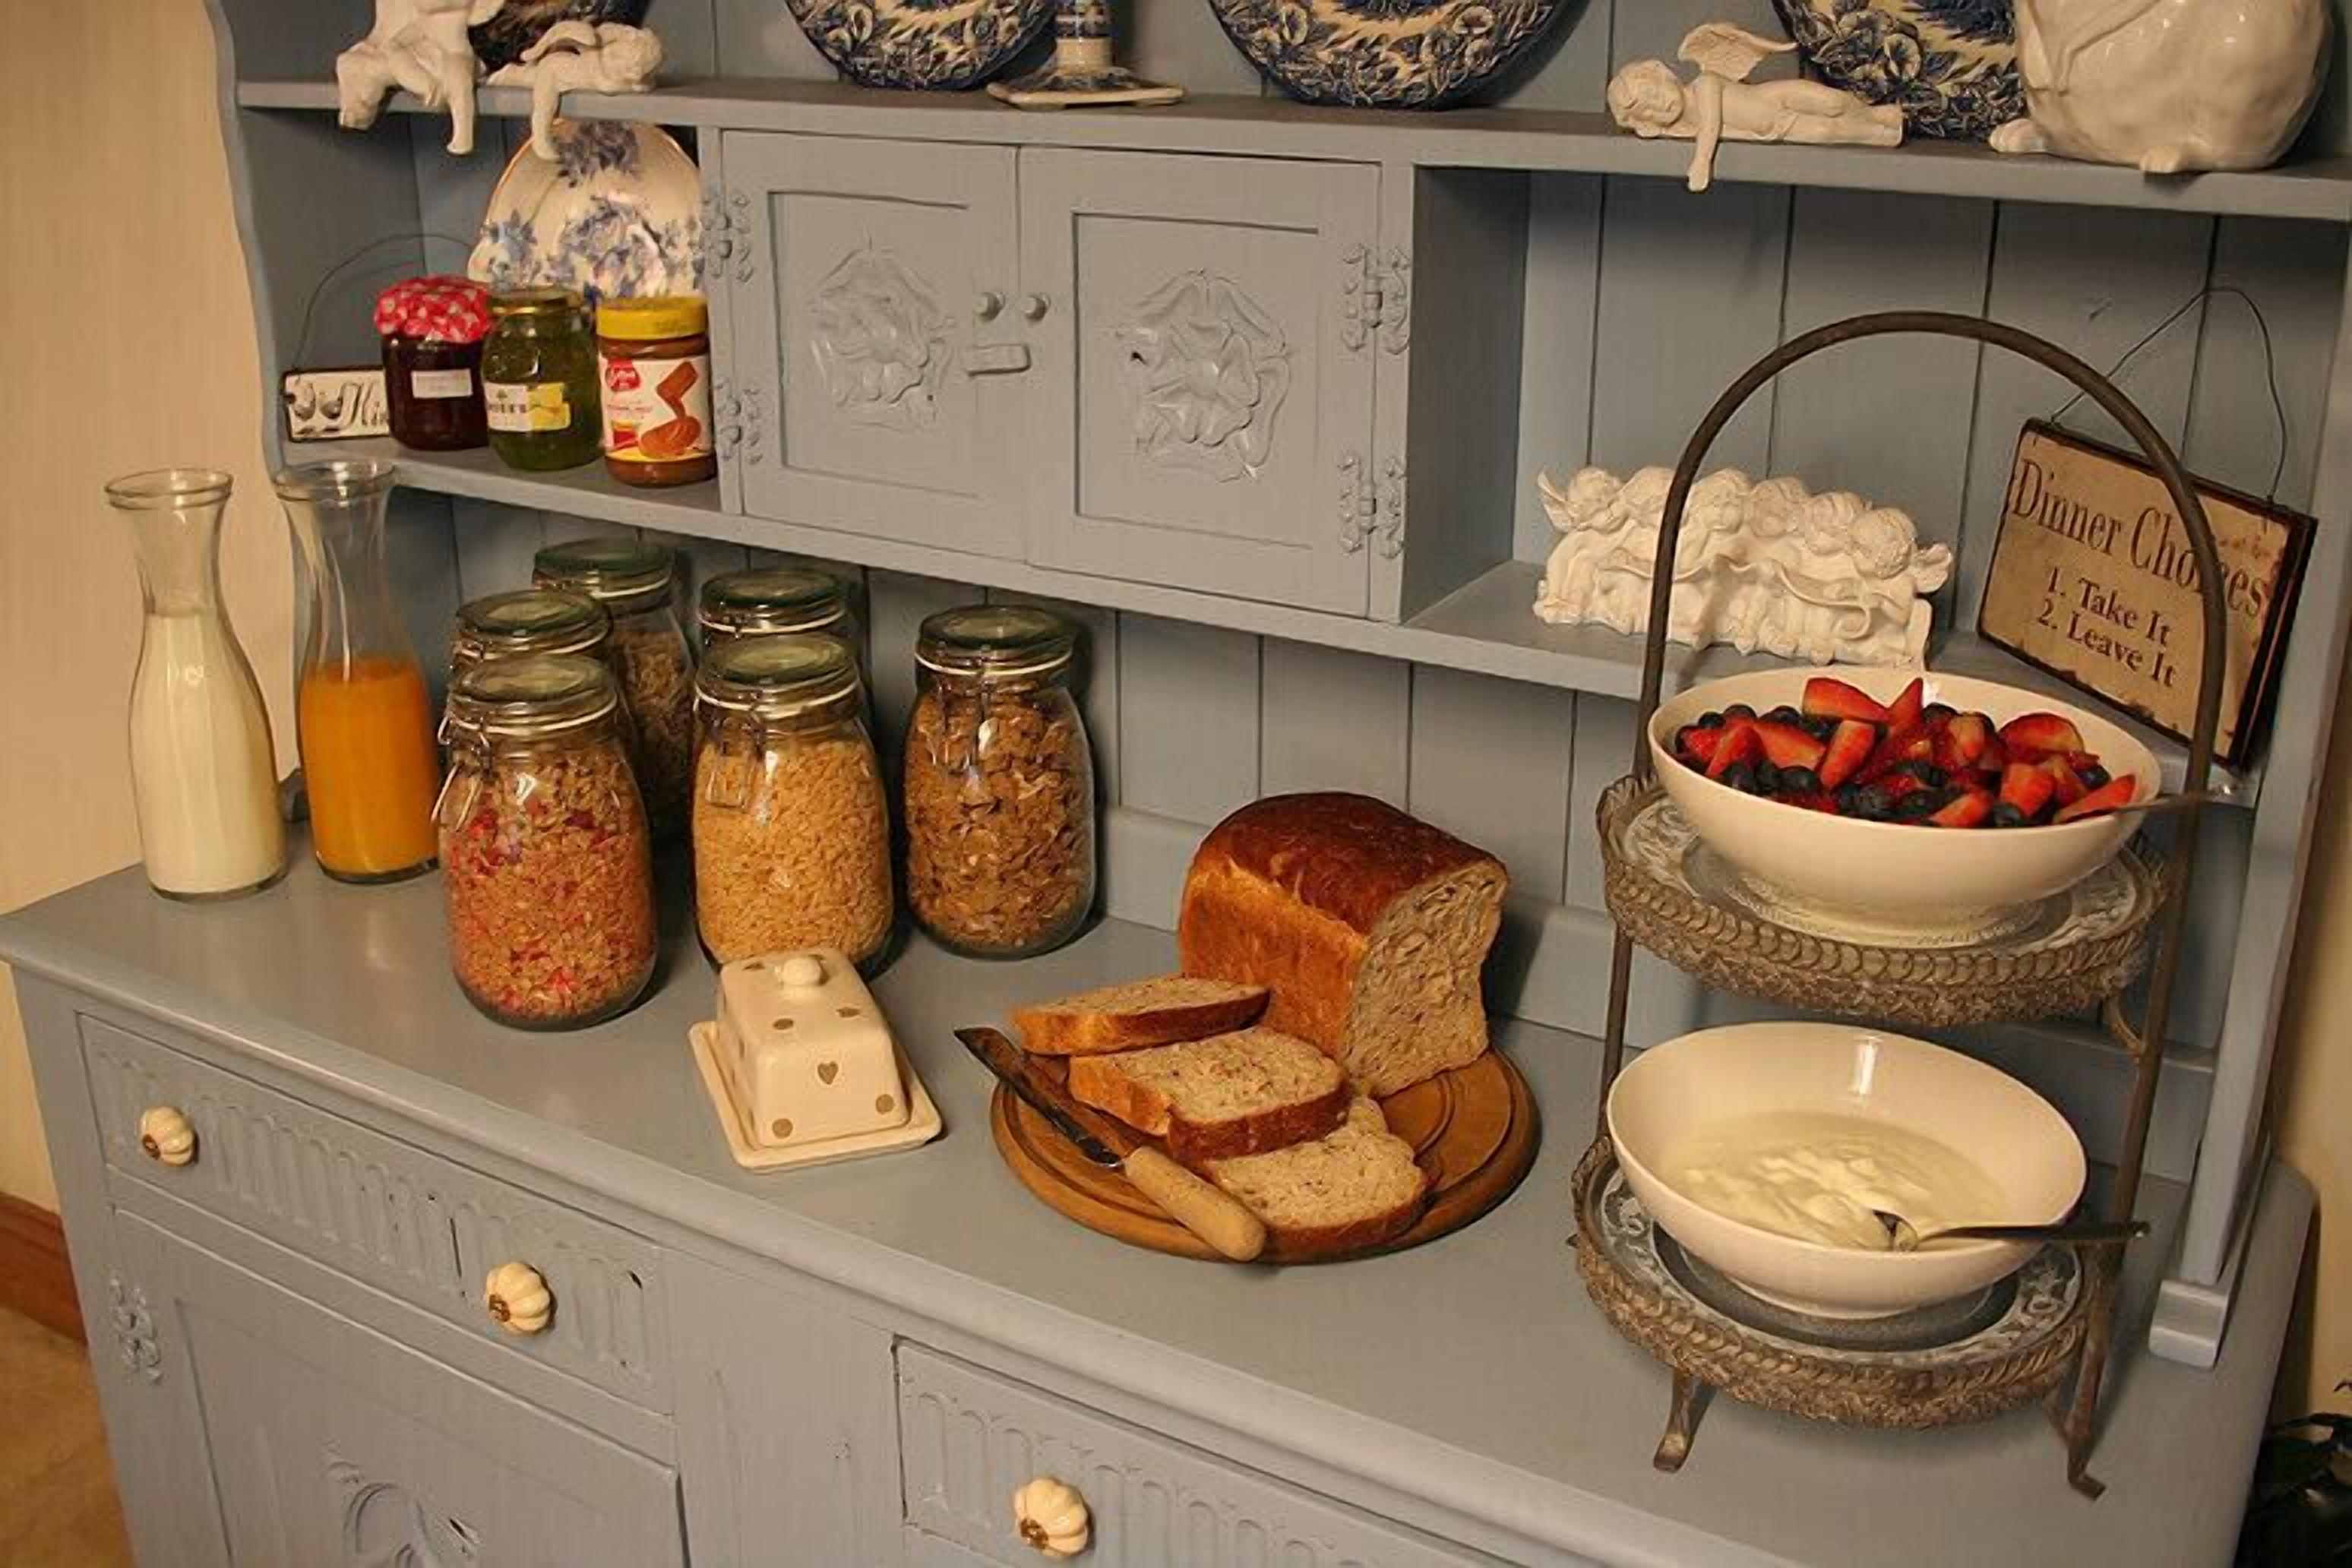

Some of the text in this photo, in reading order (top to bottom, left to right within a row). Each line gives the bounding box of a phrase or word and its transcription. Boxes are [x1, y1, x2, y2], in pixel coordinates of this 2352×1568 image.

[2012, 458, 2264, 618] Dinner Choes
[2067, 611, 2143, 672] Leave
[2151, 652, 2176, 688] It
[2079, 577, 2138, 630] Take
[2146, 611, 2170, 646] It
